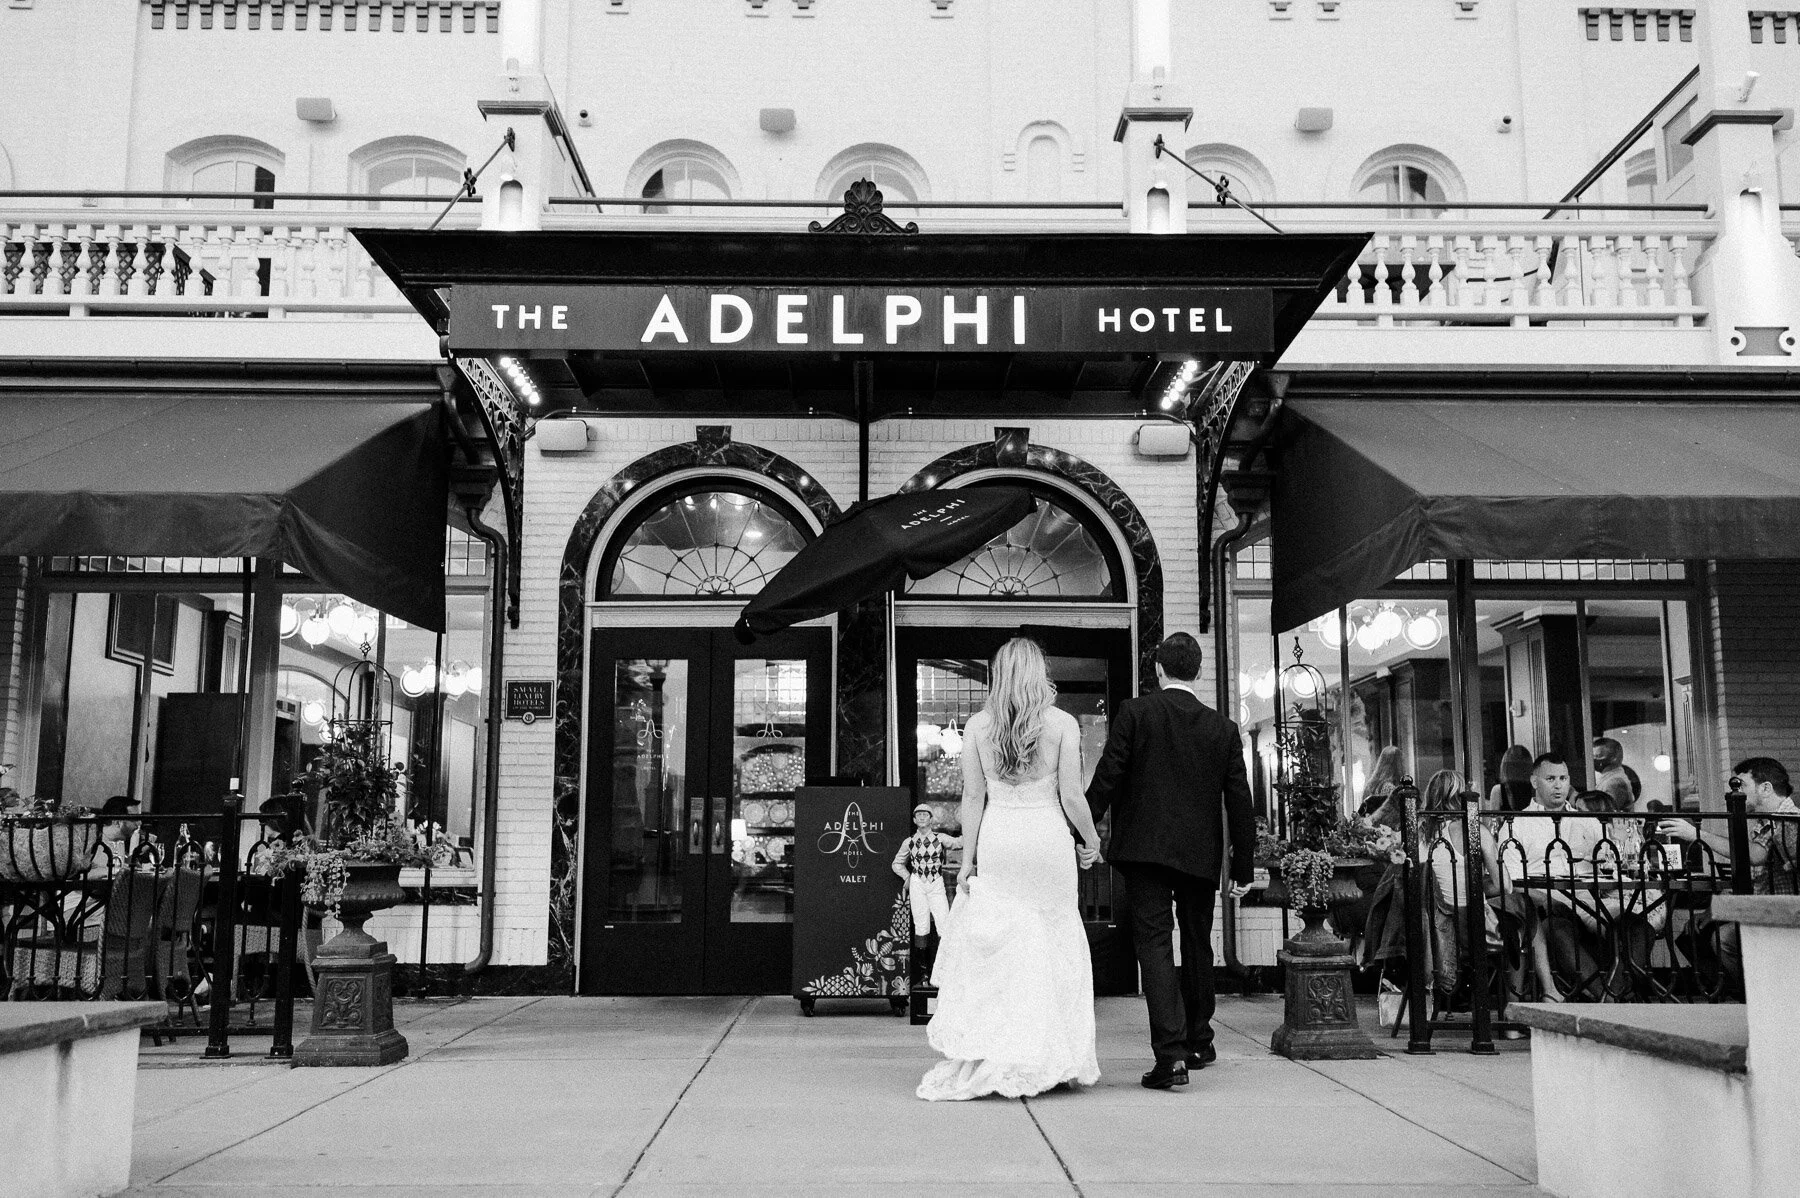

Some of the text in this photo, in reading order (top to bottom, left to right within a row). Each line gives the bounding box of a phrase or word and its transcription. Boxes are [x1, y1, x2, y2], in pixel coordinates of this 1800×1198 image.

[492, 293, 1232, 346] THE ADELPHI HOTEL
[901, 498, 966, 530] ADELPHI
[912, 509, 927, 517] THE
[824, 821, 884, 831] ADELPHI
[840, 875, 867, 883] VALET
